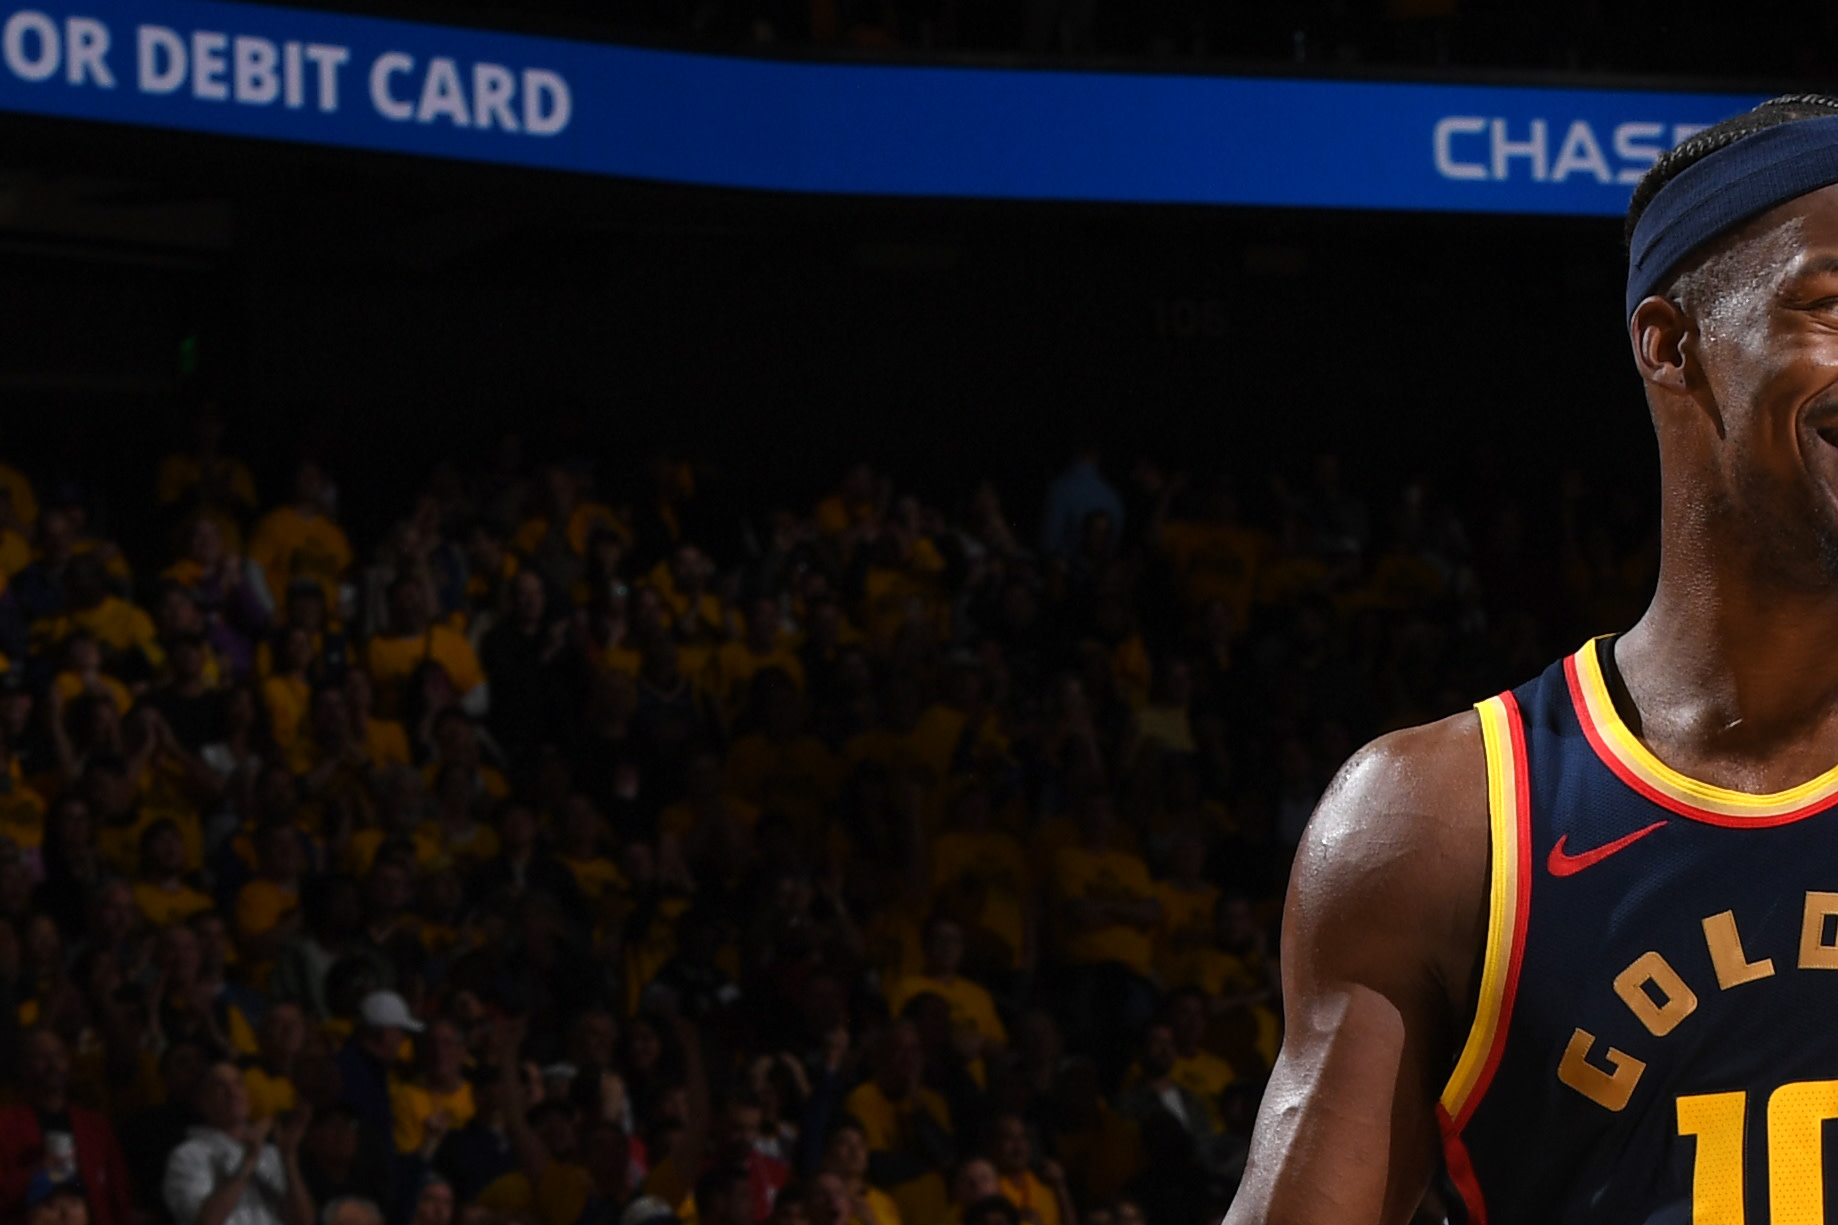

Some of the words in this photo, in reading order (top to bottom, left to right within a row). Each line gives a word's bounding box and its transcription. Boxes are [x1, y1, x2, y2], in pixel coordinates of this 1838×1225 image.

[3, 10, 116, 89] OR
[137, 24, 350, 113] DEBIT
[369, 51, 573, 136] CARD
